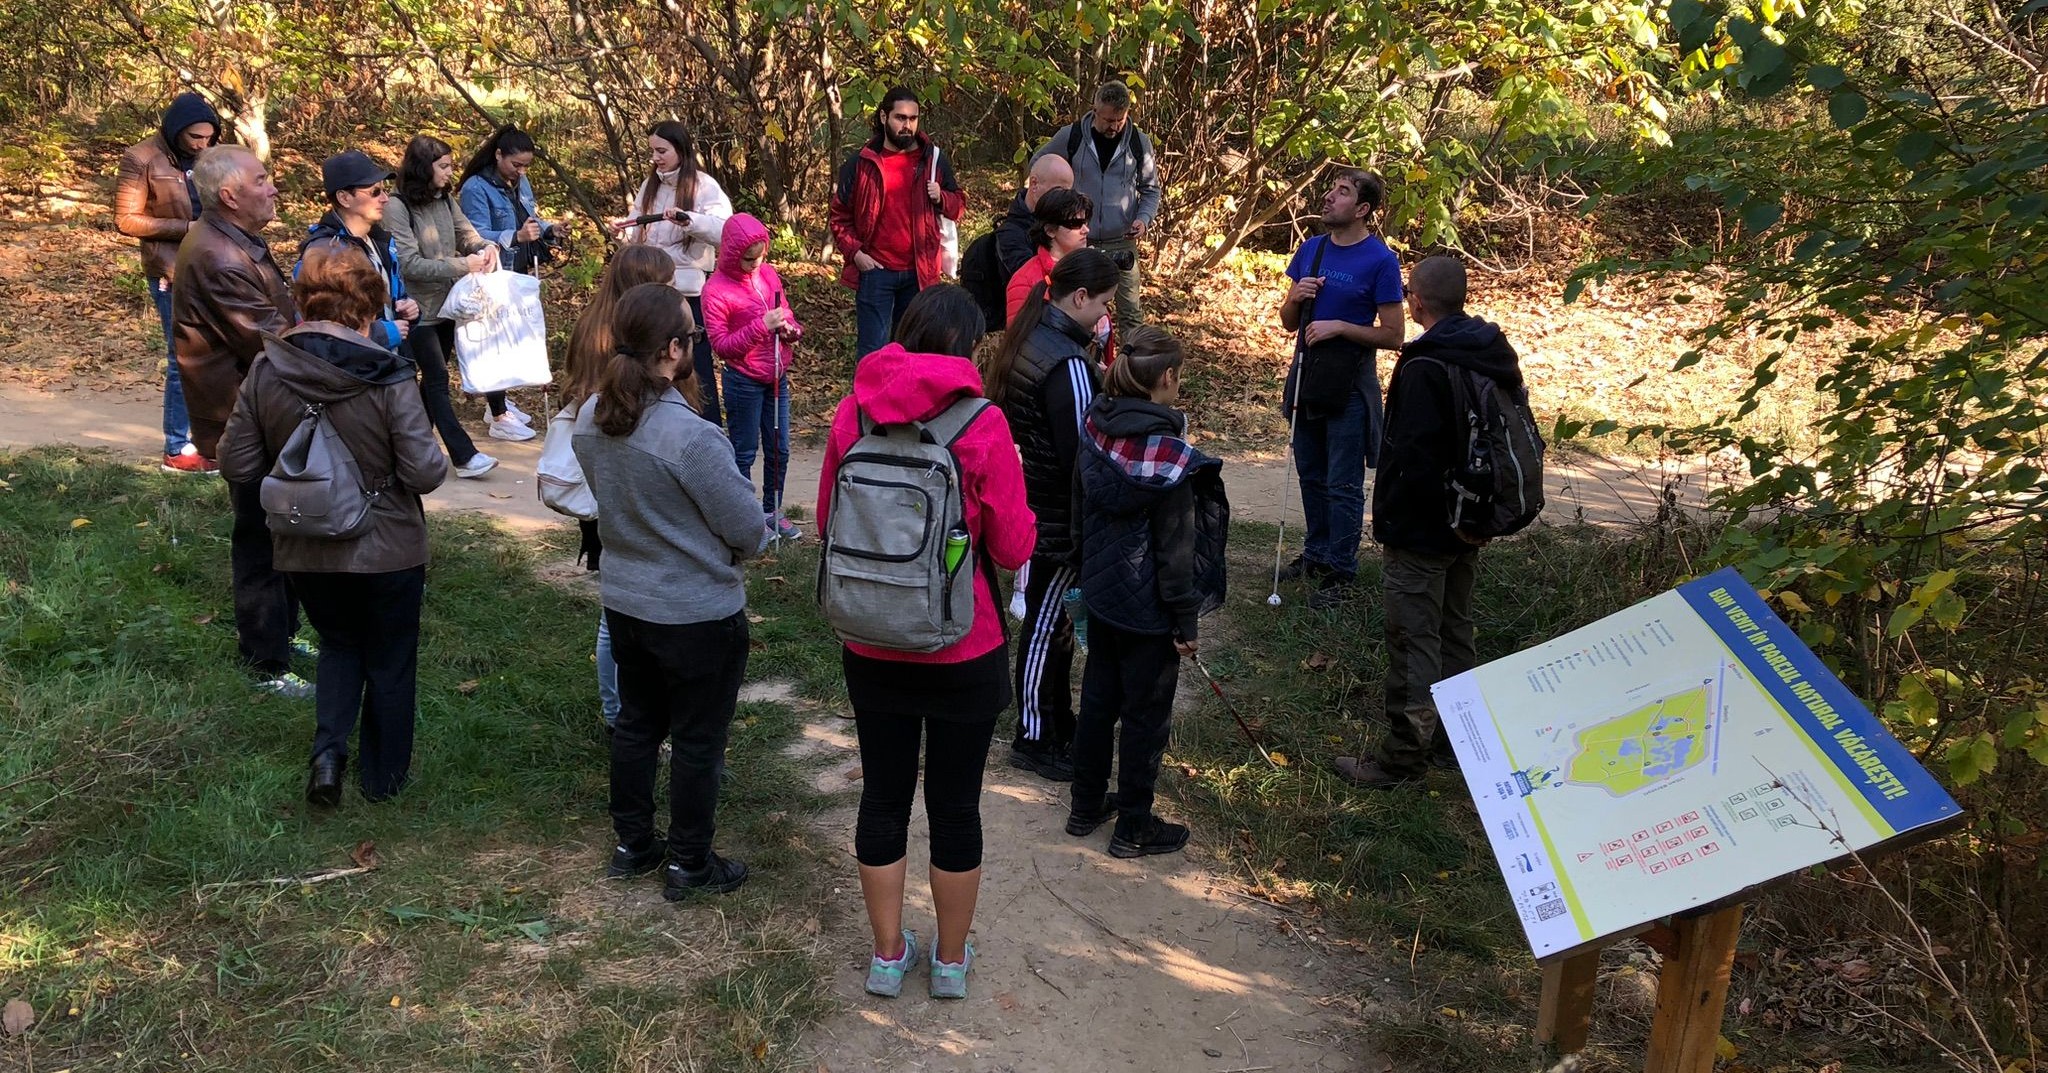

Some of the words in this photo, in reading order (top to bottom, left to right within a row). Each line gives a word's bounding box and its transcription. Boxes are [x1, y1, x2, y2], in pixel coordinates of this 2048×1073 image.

[1708, 587, 1737, 609] BUN
[1725, 605, 1760, 633] VENIT
[1746, 630, 1769, 645] ÎN
[1756, 642, 1802, 684] PARCUL
[1789, 680, 1845, 731] NATURAL
[1832, 727, 1910, 800] VĂCĂREȘTI!
